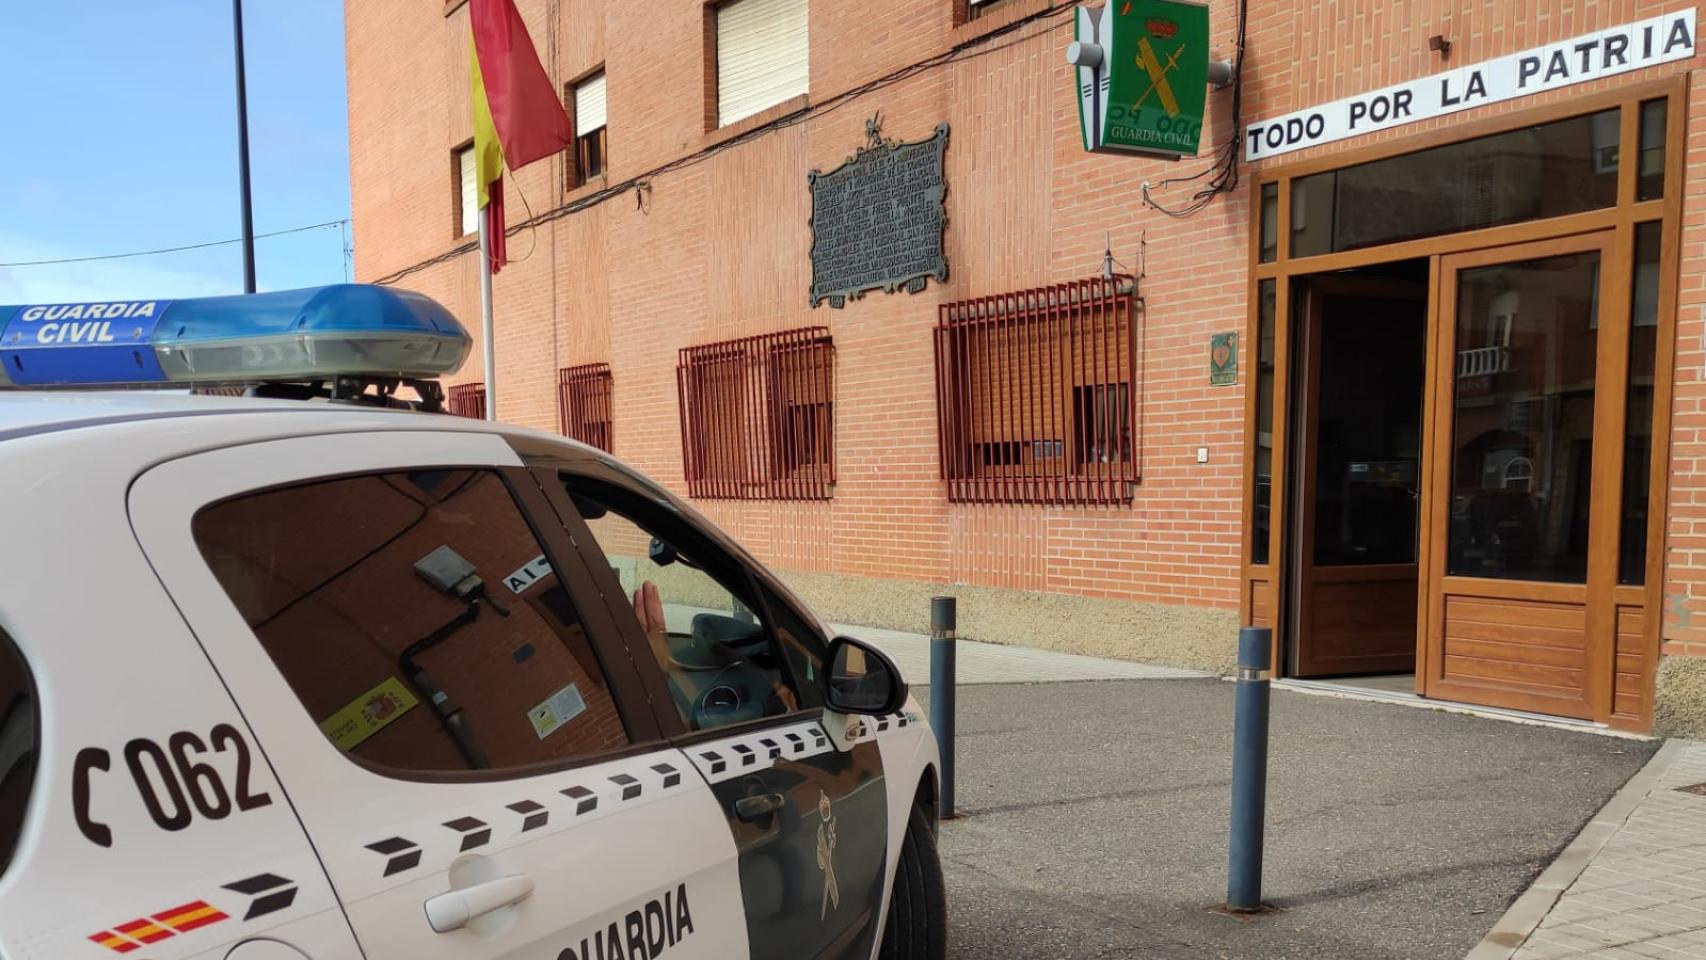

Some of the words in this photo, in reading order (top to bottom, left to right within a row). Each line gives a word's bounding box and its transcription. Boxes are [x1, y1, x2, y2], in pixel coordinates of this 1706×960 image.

[1248, 113, 1325, 154] TODO
[1349, 89, 1413, 129] POR
[1441, 70, 1488, 107] LA
[1519, 18, 1693, 88] PATRIA
[1111, 126, 1161, 143] GUARDIA
[1164, 133, 1193, 146] CIVIL
[22, 302, 156, 321] GUARDIA
[36, 322, 114, 343] CIVIL
[124, 723, 273, 831] 062
